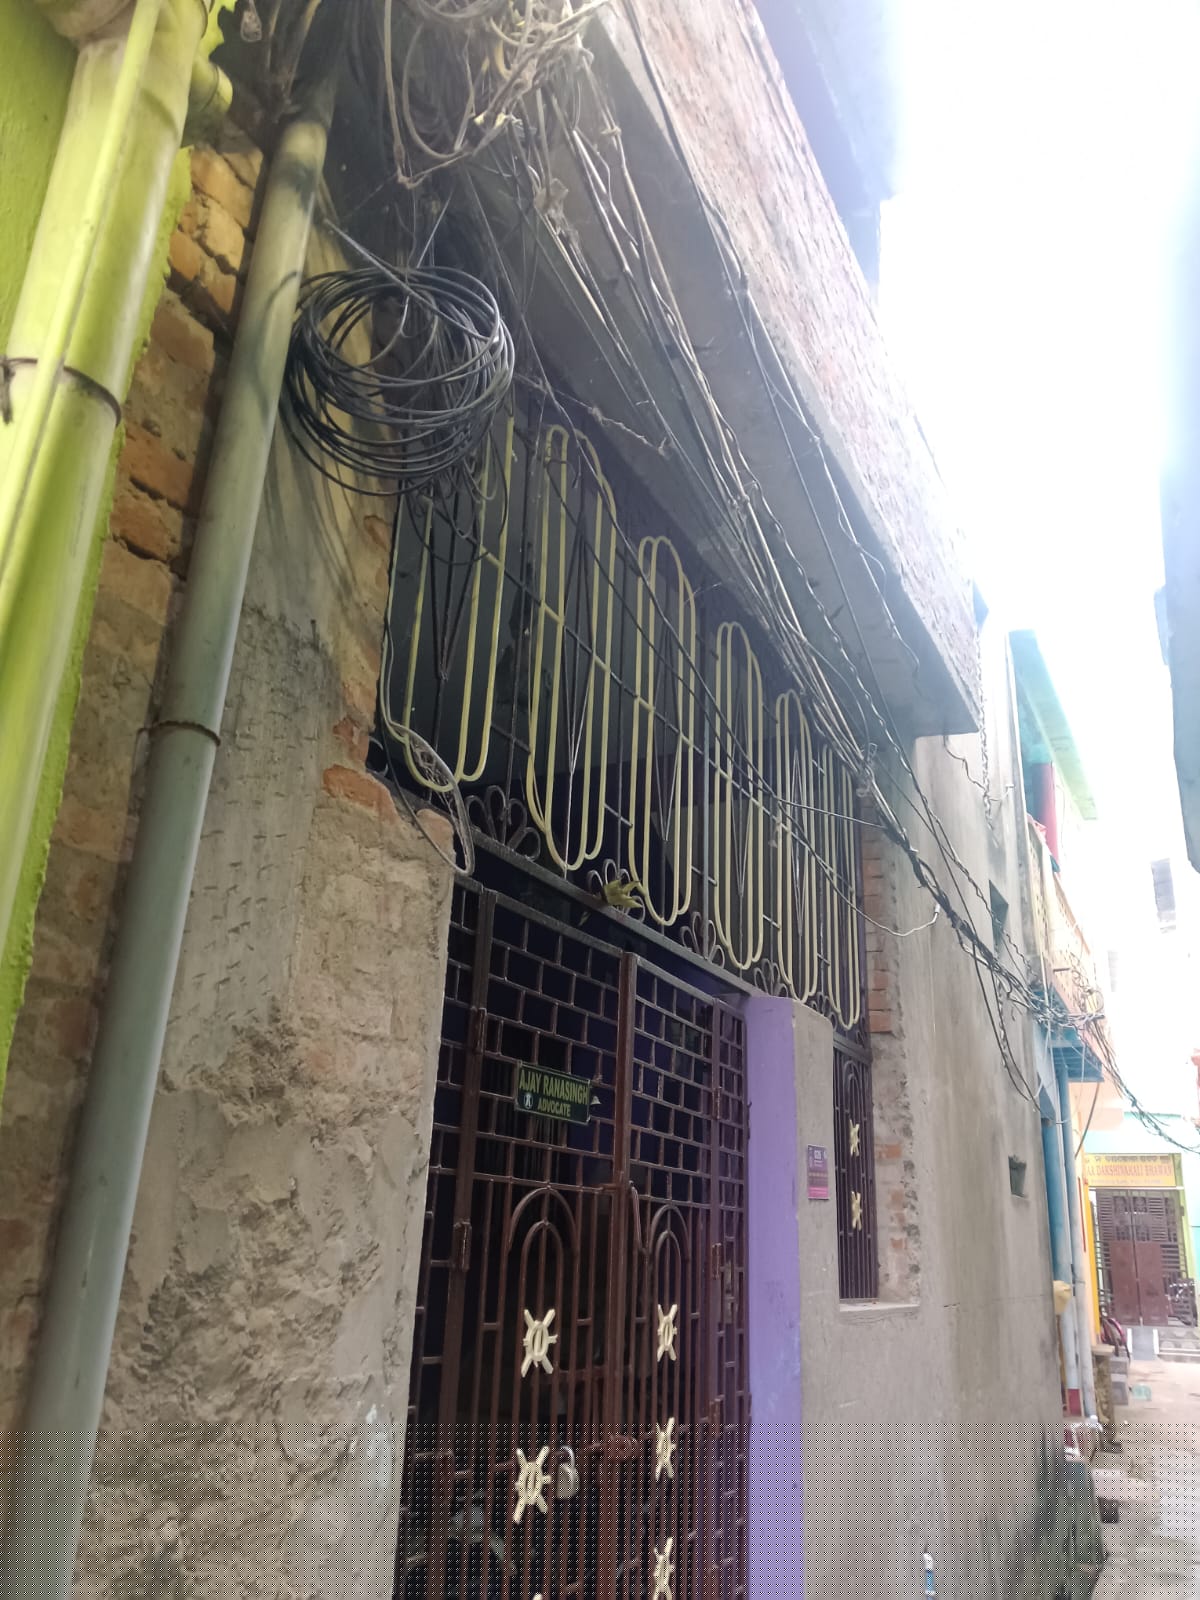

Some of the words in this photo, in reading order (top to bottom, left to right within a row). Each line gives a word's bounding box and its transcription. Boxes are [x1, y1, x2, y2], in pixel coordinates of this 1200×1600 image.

[519, 1069, 541, 1094] AJAY
[543, 1076, 588, 1105] RANASINGH
[537, 1097, 571, 1117] ADVOCATE
